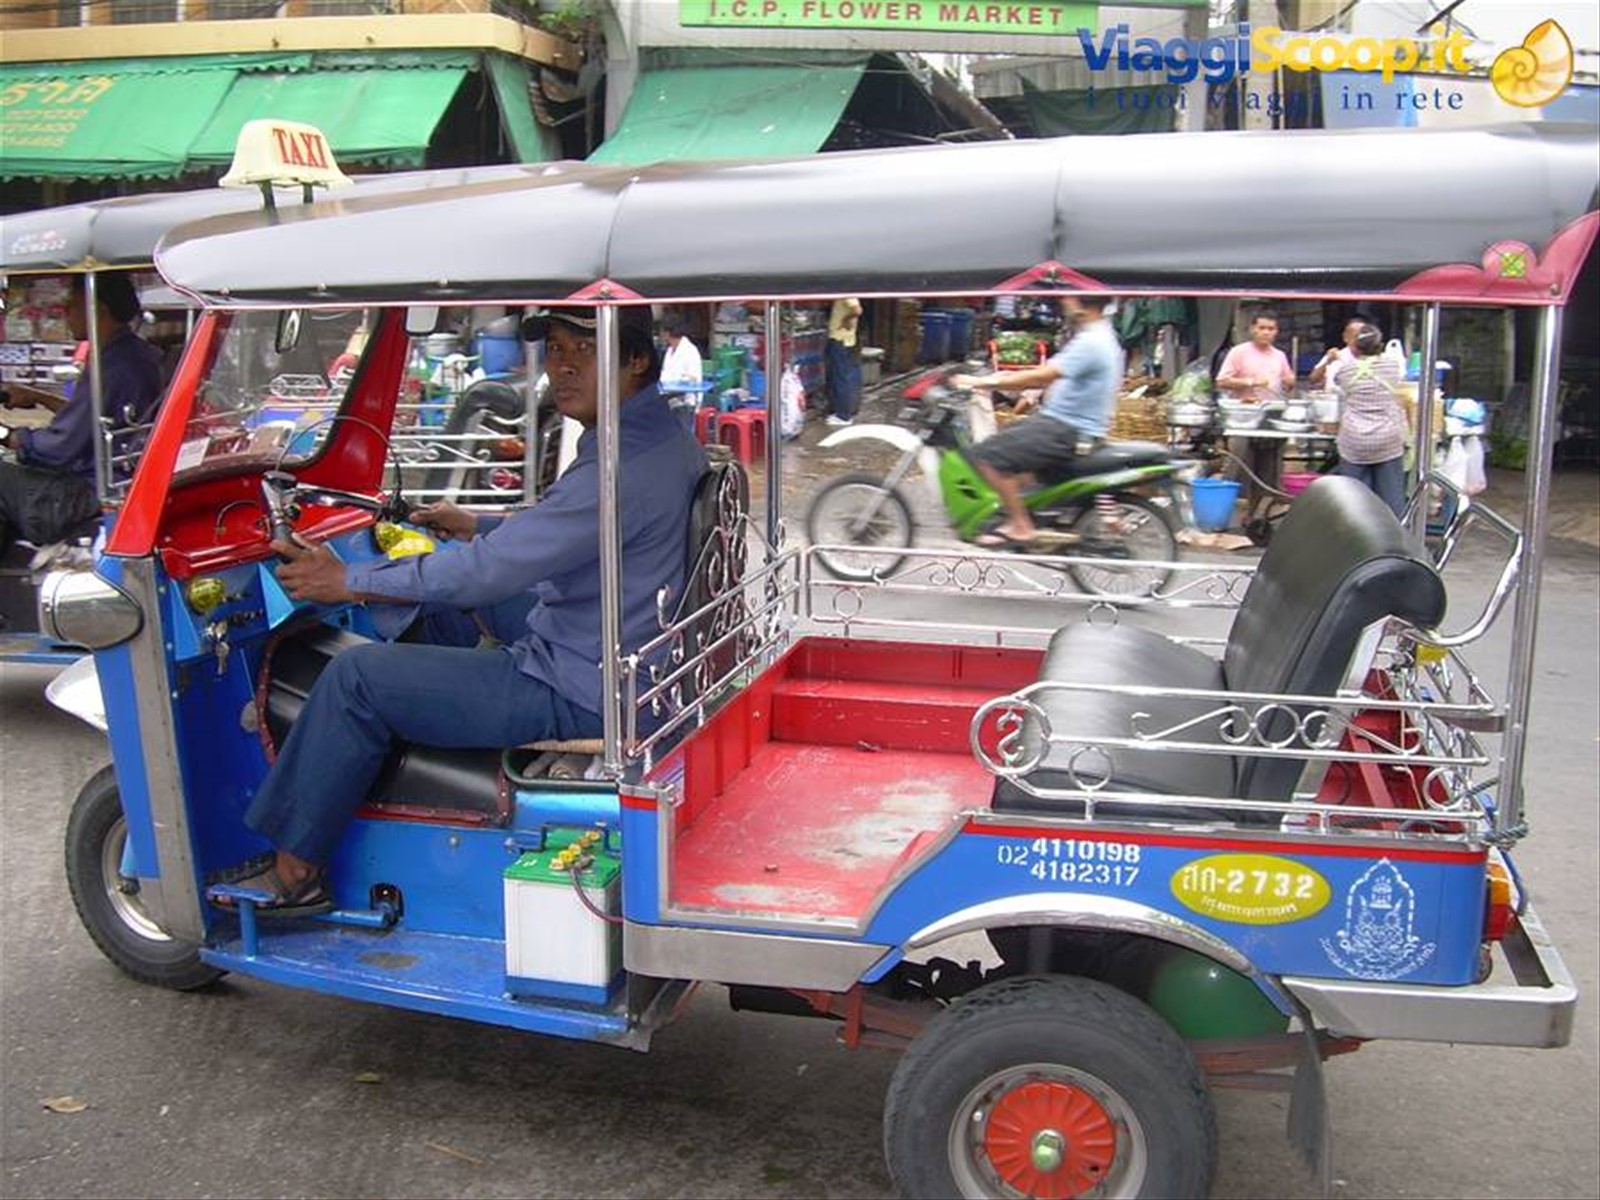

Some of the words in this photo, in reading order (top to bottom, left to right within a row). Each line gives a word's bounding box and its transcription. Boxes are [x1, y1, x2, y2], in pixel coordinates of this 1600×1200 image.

[710, 1, 788, 17] I.C.P.
[803, 1, 921, 20] FLOWER
[939, 4, 1064, 26] MARKET
[272, 127, 329, 170] TAXI
[998, 845, 1028, 866] 02
[1032, 838, 1140, 863] 4110198
[1031, 860, 1139, 886] 4182317
